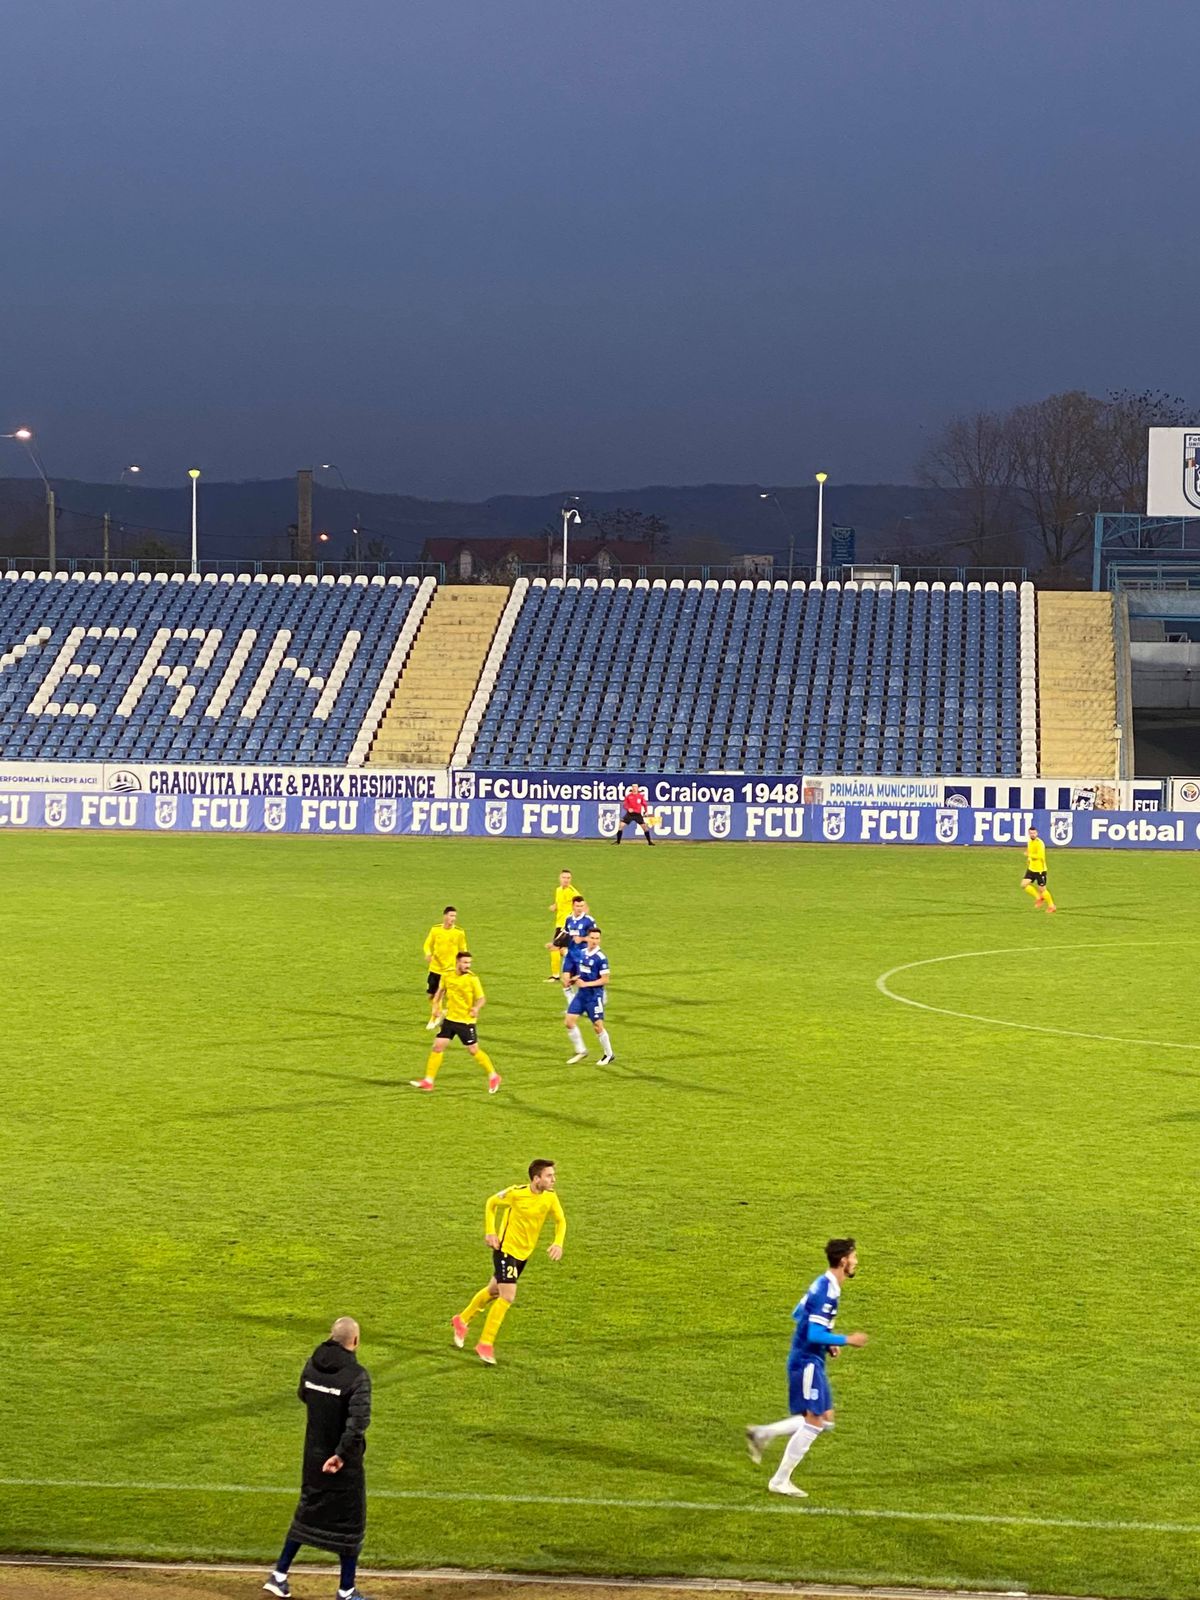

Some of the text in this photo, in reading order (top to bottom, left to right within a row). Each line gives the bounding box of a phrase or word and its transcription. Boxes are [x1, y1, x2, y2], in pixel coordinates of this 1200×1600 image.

[150, 771, 435, 798] CRAIOVITA LAKE & PARK RESIDENCE
[655, 781, 734, 802] Craiova
[741, 783, 798, 804] 1948
[877, 783, 939, 799] MUNICIPIULUI
[80, 796, 139, 826] FCU
[191, 798, 250, 829] FCU
[300, 800, 359, 831] FCU
[411, 801, 470, 832] FCU
[522, 803, 581, 835] FCU
[1134, 799, 1159, 811] FCU
[746, 806, 805, 838] FCU
[860, 809, 920, 841] FCU
[973, 811, 1034, 843] FCU
[1091, 818, 1184, 842] Fotbal
